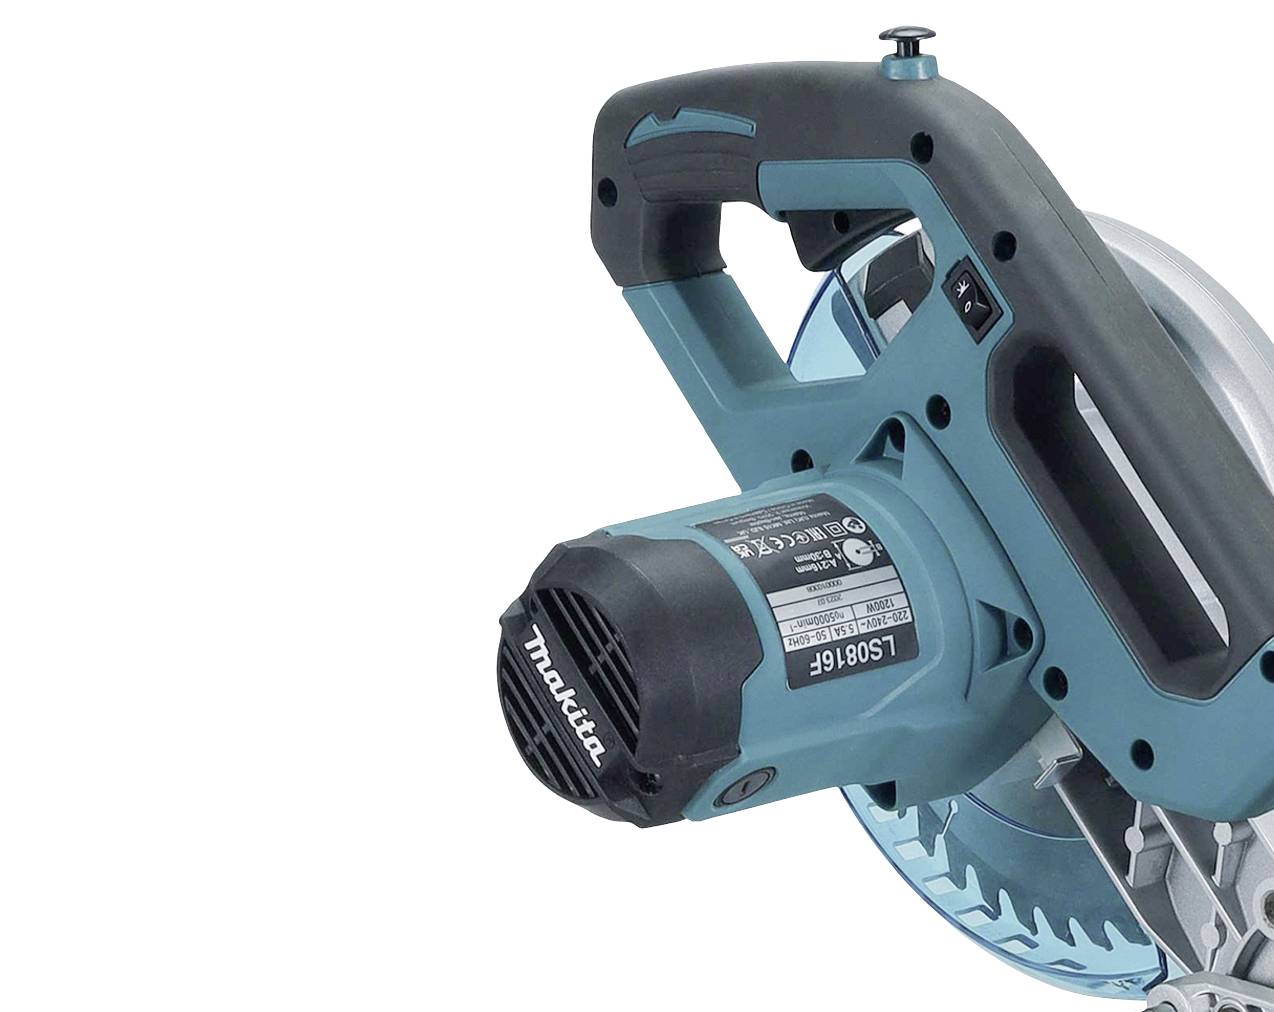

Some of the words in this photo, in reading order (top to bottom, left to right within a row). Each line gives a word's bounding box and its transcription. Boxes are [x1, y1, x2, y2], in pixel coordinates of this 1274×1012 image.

[866, 597, 895, 614] 1200W
[788, 629, 827, 647] 50-60Hz
[834, 623, 855, 636] 5.5A
[809, 634, 896, 677] LS0816F
[524, 623, 607, 768] makita
